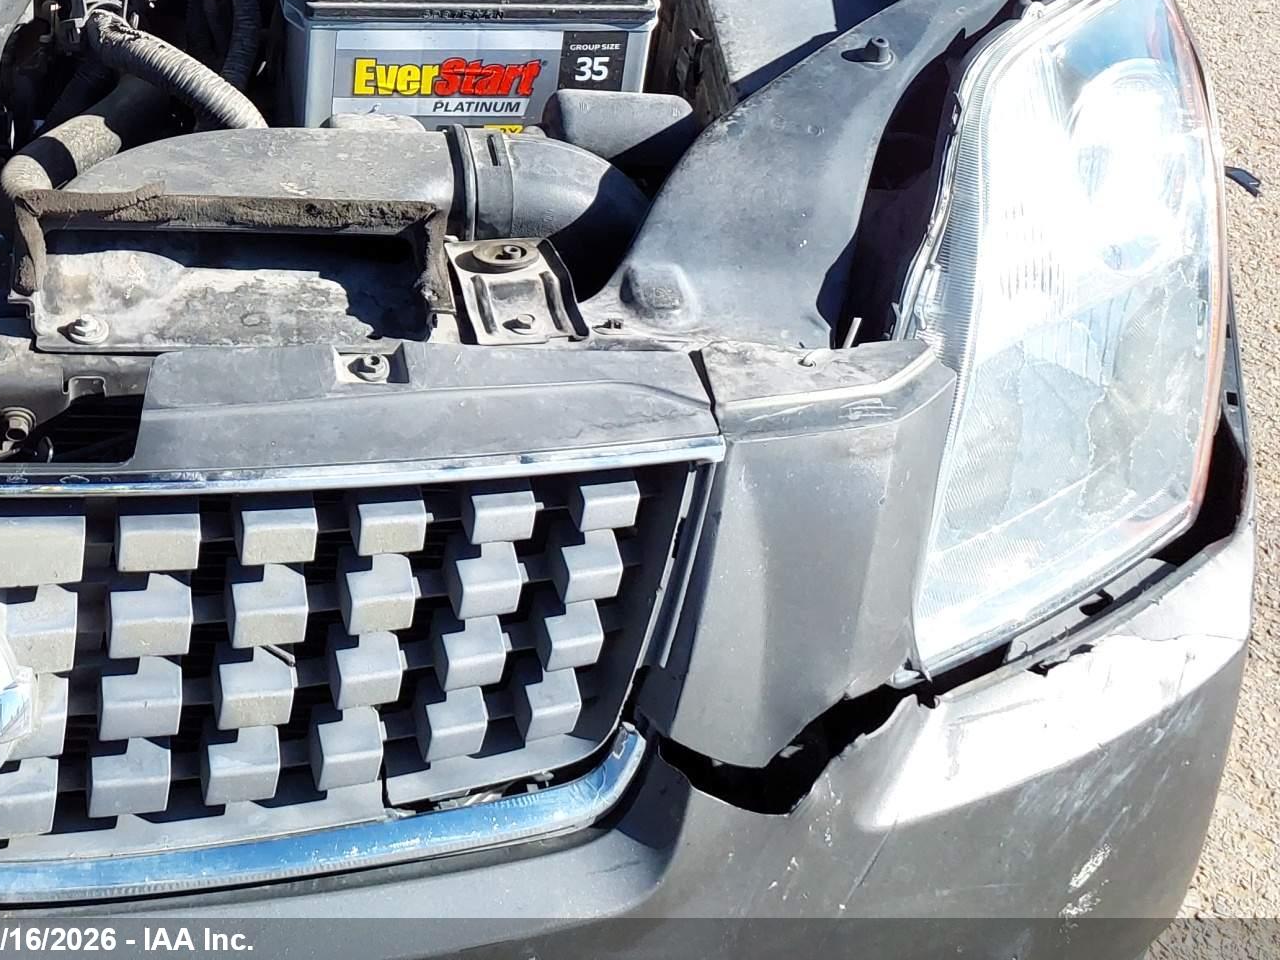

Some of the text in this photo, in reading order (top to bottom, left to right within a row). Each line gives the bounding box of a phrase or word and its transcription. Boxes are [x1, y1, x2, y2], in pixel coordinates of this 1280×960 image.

[569, 43, 600, 51] GROUP
[352, 57, 542, 97] EverStart
[575, 56, 610, 81] 35
[432, 101, 521, 114] PLATINUM
